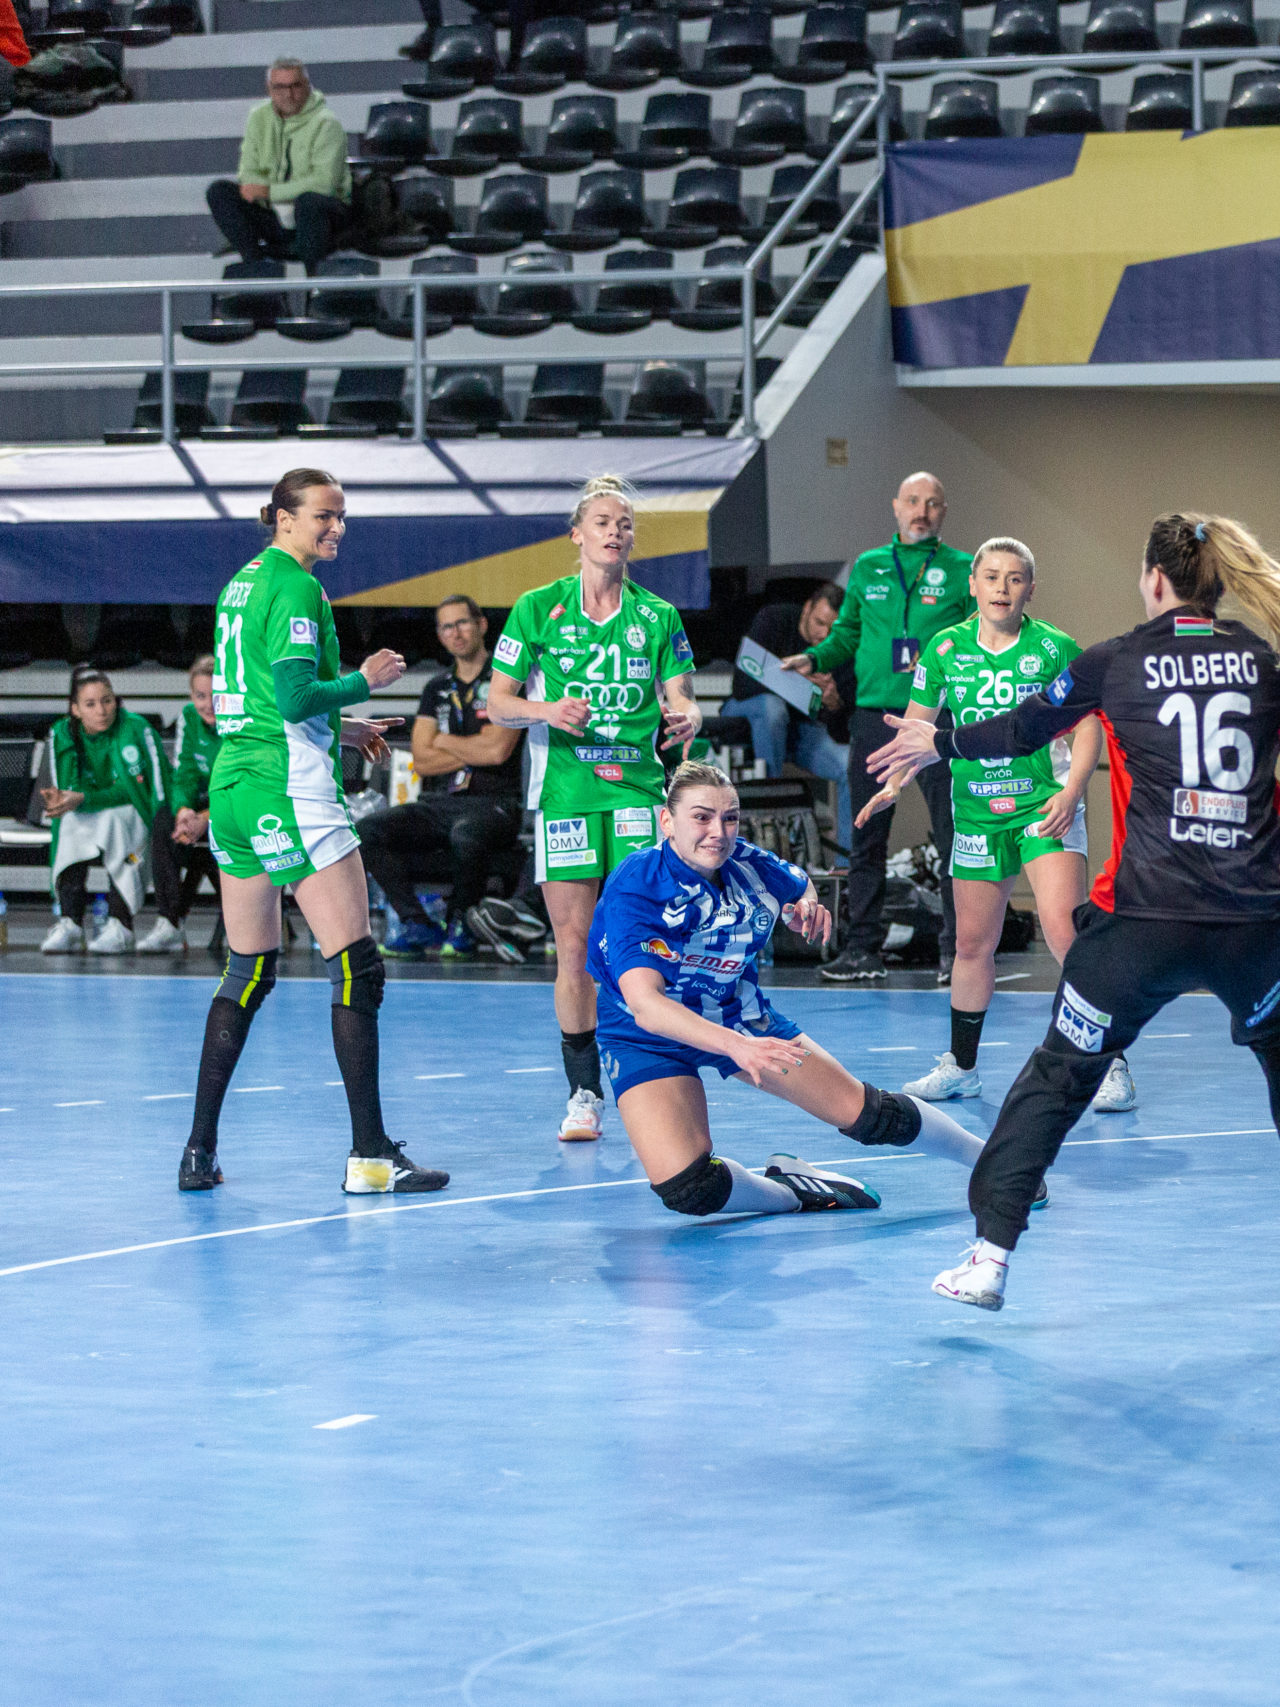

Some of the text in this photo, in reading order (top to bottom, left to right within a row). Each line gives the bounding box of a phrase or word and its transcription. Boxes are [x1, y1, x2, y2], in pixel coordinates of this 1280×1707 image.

[212, 612, 247, 692] 31
[586, 643, 620, 681] 21
[901, 646, 910, 664] A
[1144, 652, 1258, 689] SOLBERG
[976, 669, 1013, 705] 26
[1157, 691, 1255, 791] 16
[598, 769, 619, 777] TCL
[992, 802, 1013, 810] TCL
[550, 836, 584, 850] OMV
[957, 838, 983, 852] OMV
[1170, 818, 1253, 849] Leier
[1060, 1019, 1096, 1050] OMV
